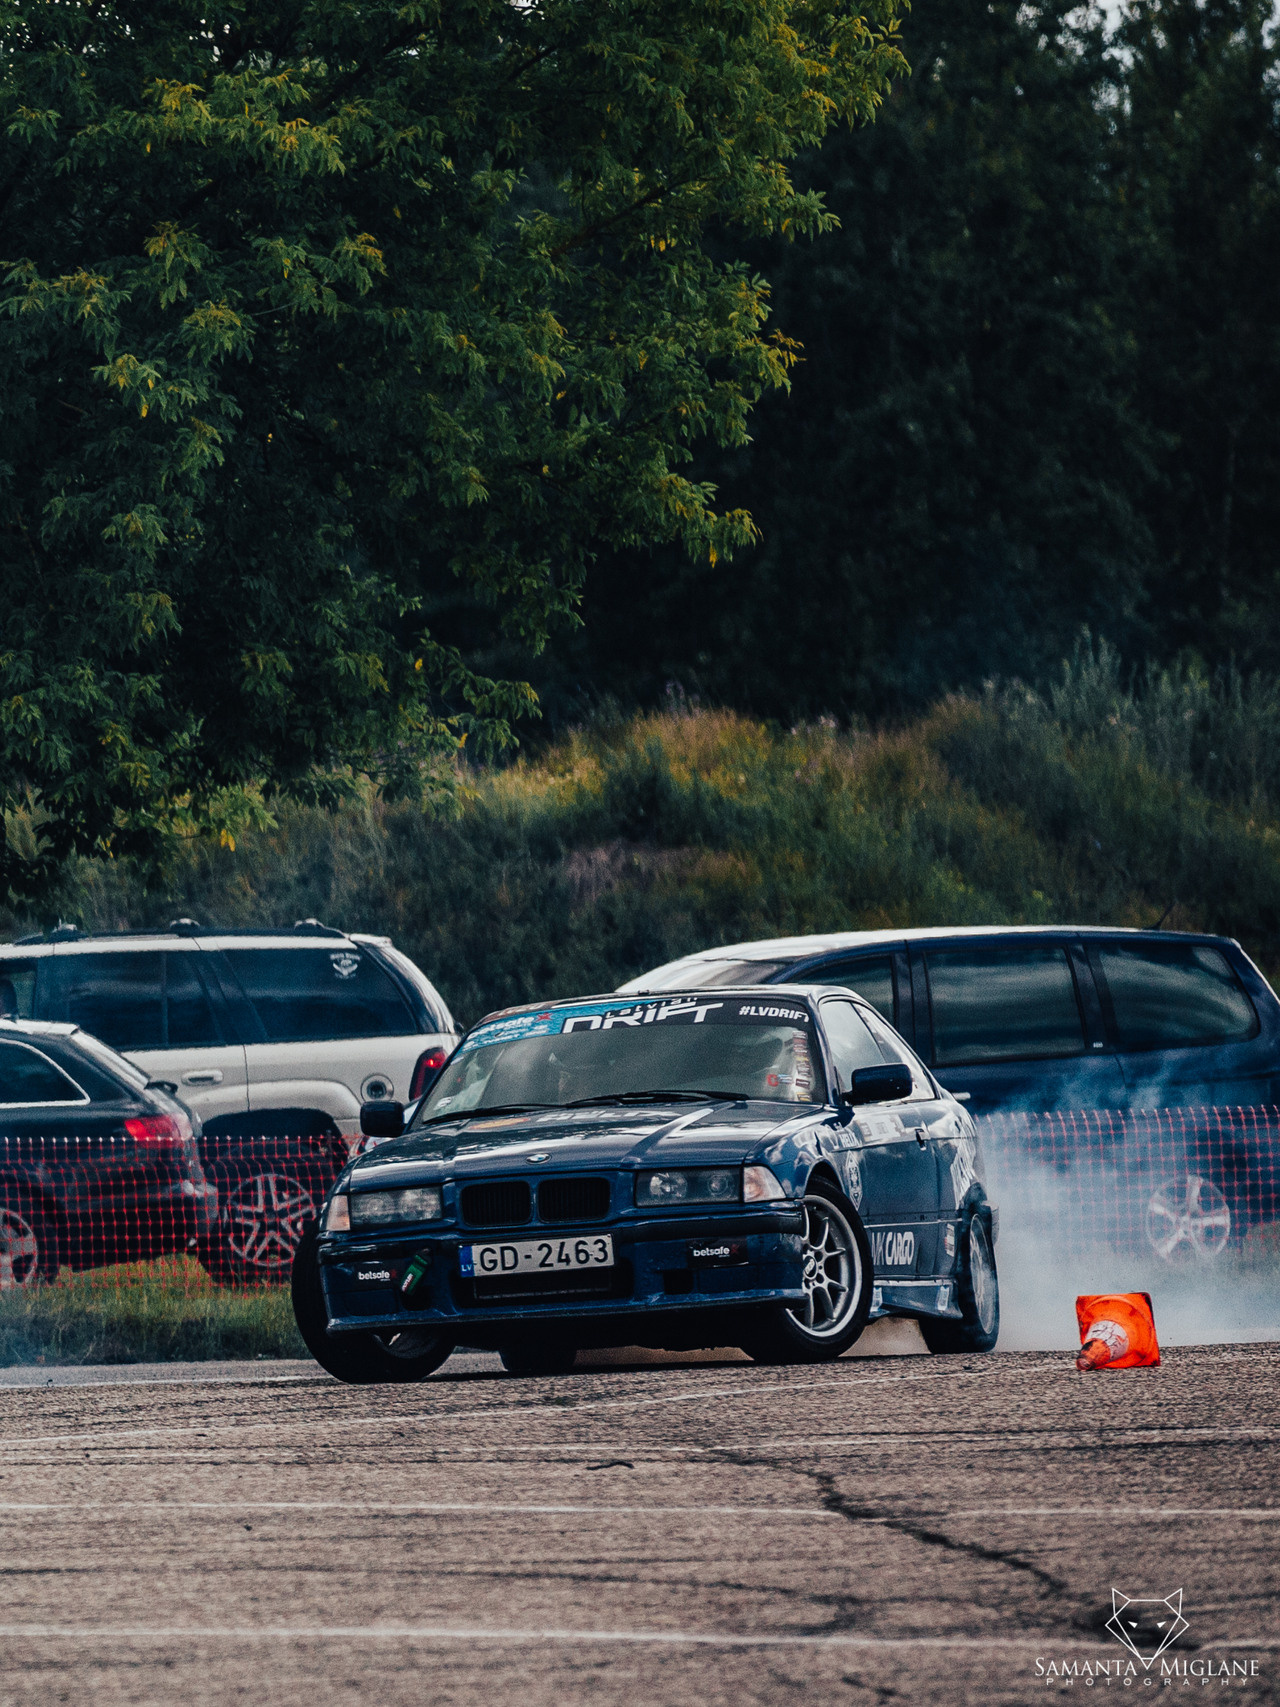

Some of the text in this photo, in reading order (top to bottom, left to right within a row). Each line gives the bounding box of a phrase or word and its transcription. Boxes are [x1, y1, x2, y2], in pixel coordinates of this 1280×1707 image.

[562, 1002, 723, 1034] DRIFT
[739, 1005, 810, 1023] #LVDRIFT
[479, 1238, 609, 1273] GD-2463
[693, 1245, 730, 1257] betsafe
[885, 1231, 915, 1266] CARGO
[358, 1270, 391, 1281] betsafe
[461, 1263, 473, 1272] LV
